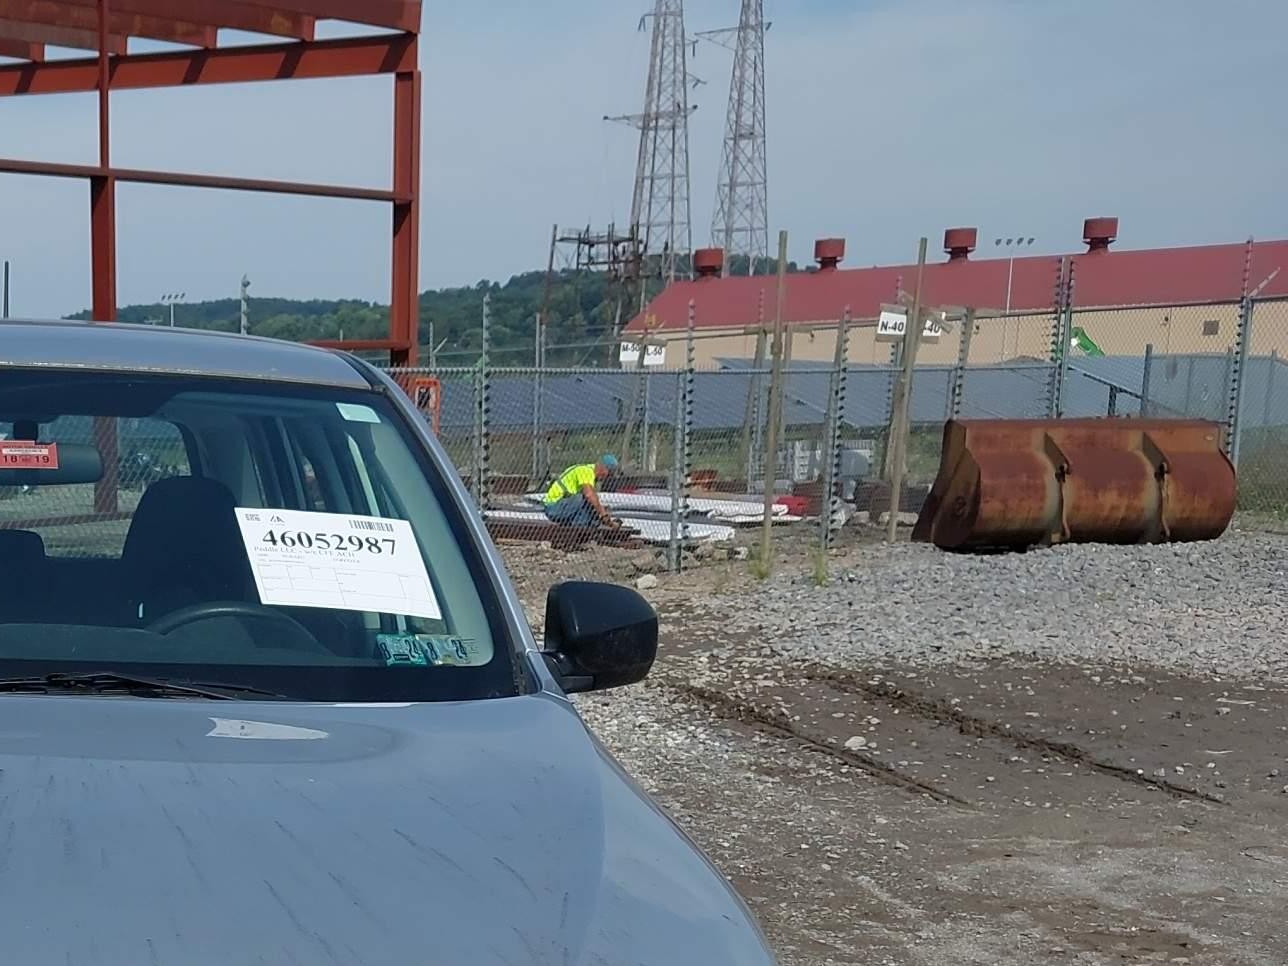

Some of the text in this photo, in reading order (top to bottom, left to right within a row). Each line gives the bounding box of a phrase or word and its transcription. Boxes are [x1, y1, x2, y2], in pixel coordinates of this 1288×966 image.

[880, 320, 905, 333] N-40
[622, 342, 641, 352] M-50
[646, 345, 663, 356] L-50
[35, 455, 50, 464] 19
[262, 529, 396, 556] 46052987
[426, 641, 439, 661] 8
